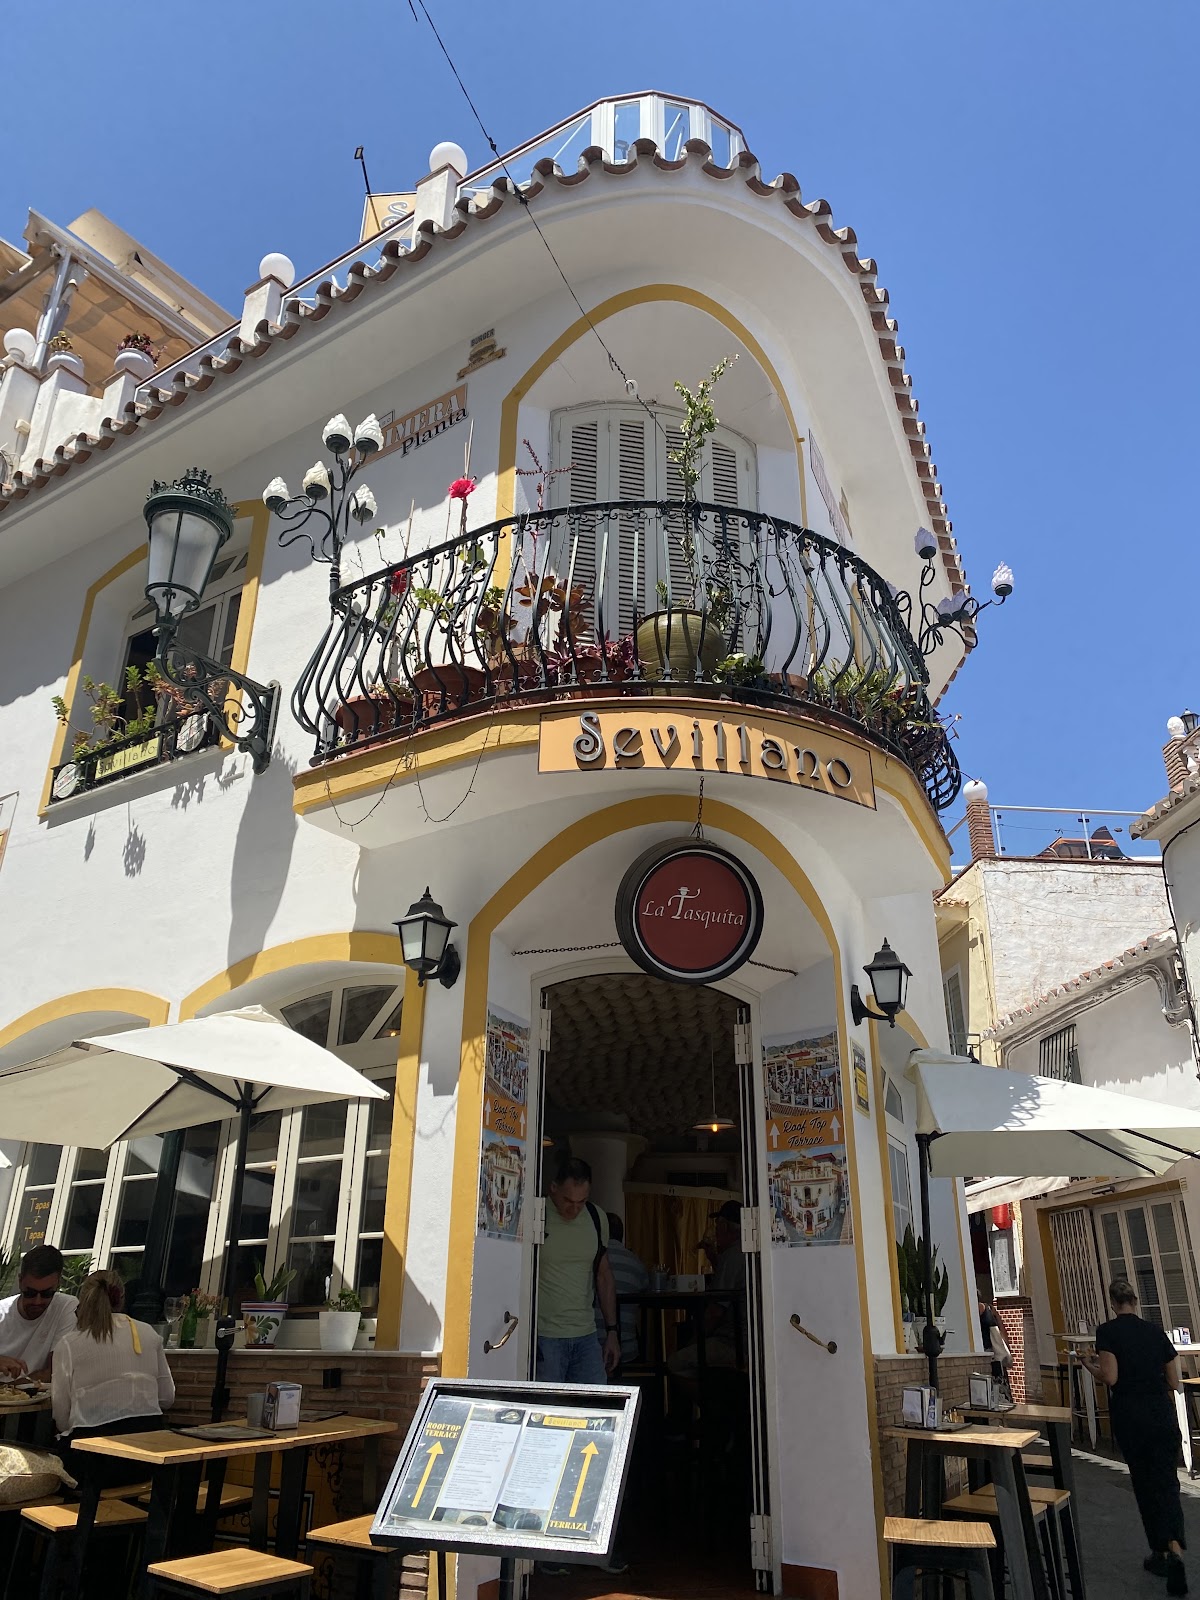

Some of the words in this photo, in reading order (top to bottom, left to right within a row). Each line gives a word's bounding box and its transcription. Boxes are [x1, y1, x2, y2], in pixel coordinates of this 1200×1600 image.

[471, 328, 495, 347] BURGER
[401, 408, 467, 456] Planta
[573, 712, 852, 788] Sevillano
[642, 901, 665, 917] La
[668, 887, 745, 929] Tasquita
[783, 1119, 807, 1134] Roof
[809, 1116, 827, 1132] Top
[787, 1135, 825, 1148] Terrace
[30, 1197, 50, 1215] Tapas
[24, 1226, 45, 1245] Tapas
[425, 1429, 459, 1439] TERRACE
[426, 1422, 461, 1432] ROOFTOP
[550, 1520, 587, 1531] TERRAZA
